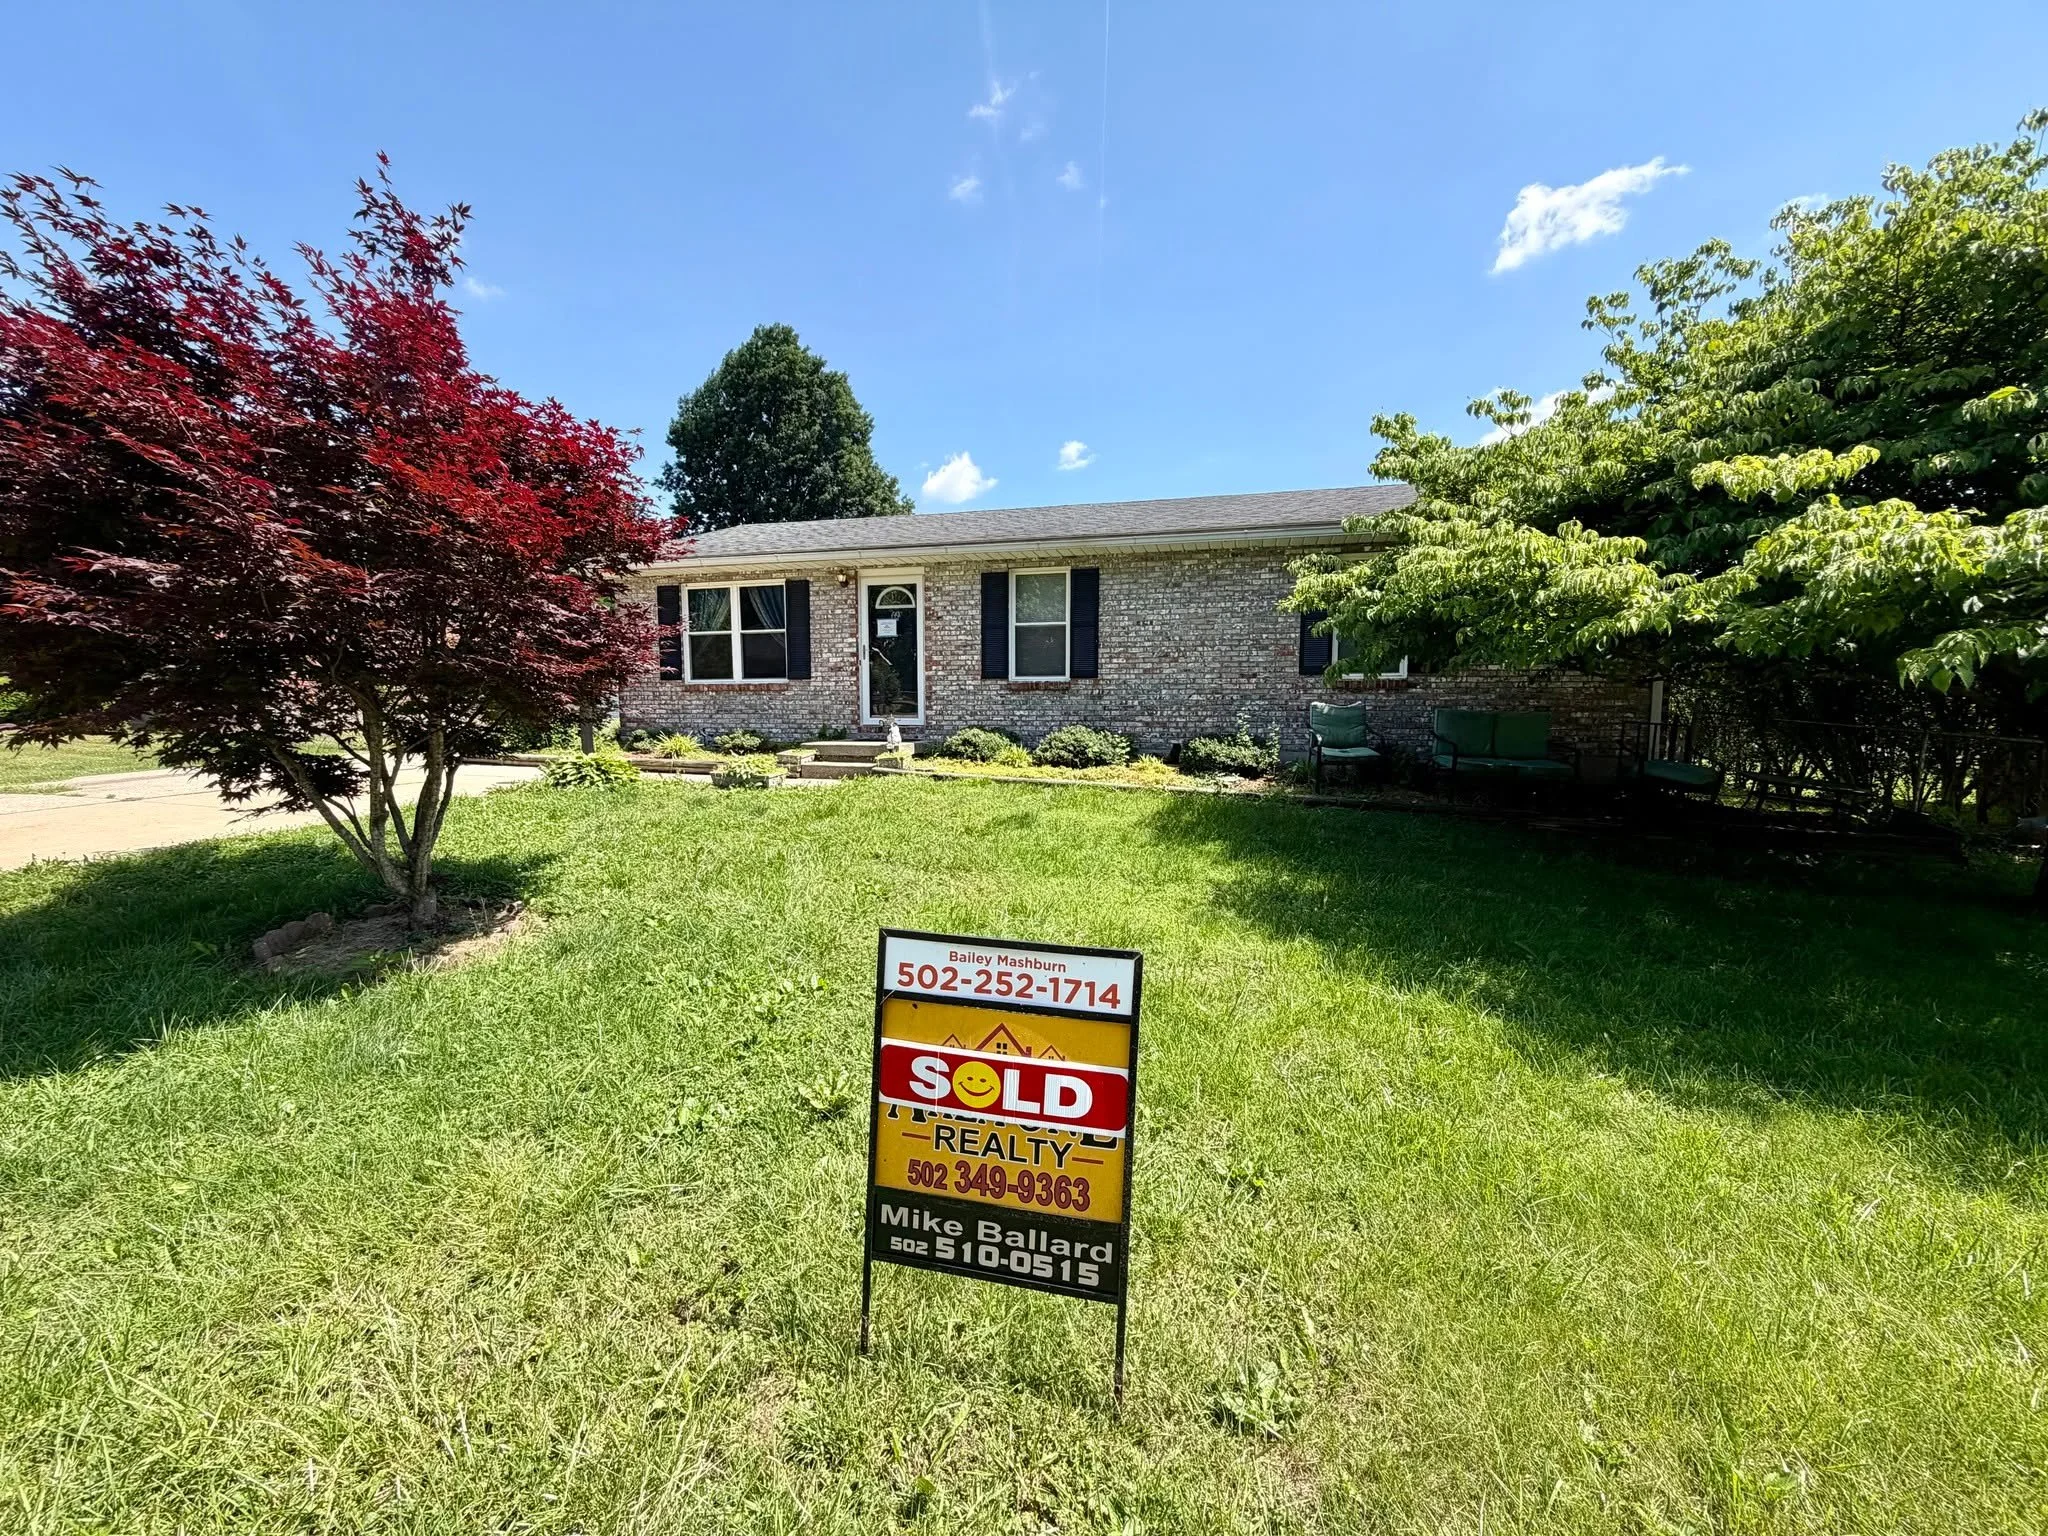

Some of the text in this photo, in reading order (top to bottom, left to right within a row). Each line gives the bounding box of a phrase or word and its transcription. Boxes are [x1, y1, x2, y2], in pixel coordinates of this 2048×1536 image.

[897, 962, 1120, 1009] 502-252-1714
[949, 951, 1066, 973] Bailey Mashburn
[909, 1056, 1093, 1119] SOLD
[933, 1123, 1073, 1168] REALTY
[908, 1159, 1090, 1212] 502 349-9363
[881, 1204, 1112, 1264] Mike Ballard
[890, 1236, 1099, 1287] 502 510-0515
